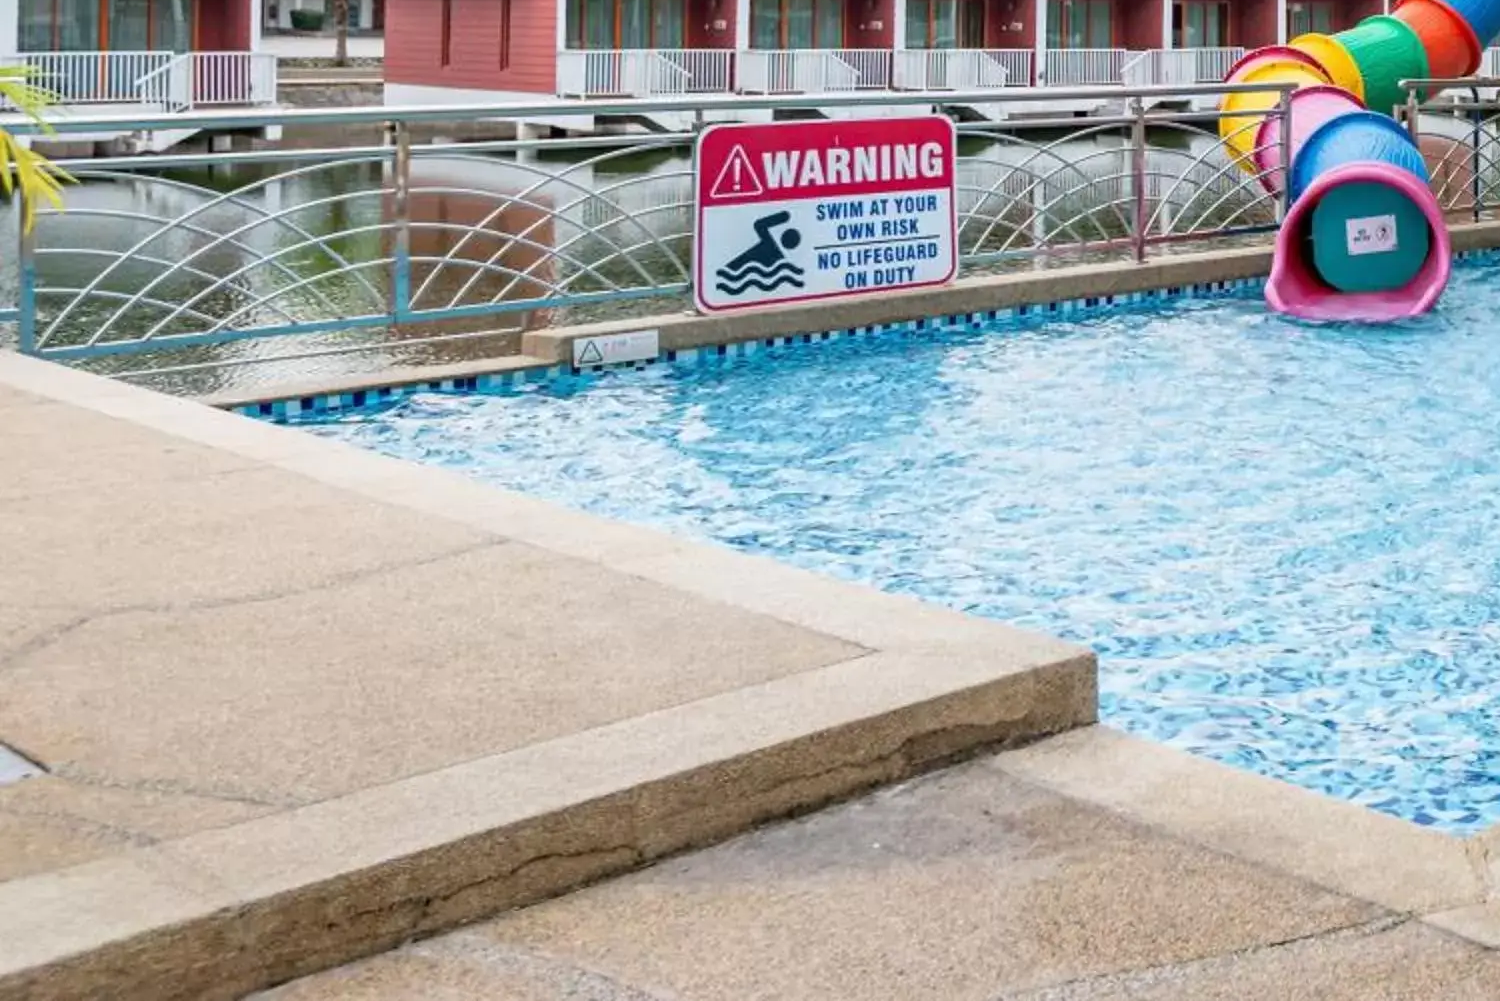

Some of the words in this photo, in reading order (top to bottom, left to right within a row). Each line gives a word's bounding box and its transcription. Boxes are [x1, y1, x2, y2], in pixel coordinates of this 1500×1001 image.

[761, 141, 944, 190] WARNING
[816, 201, 863, 221] SWIM
[870, 199, 889, 215] AT
[894, 195, 937, 214] YOUR
[837, 222, 875, 241] OWN
[881, 219, 919, 236] RISK
[818, 252, 841, 270] NO
[847, 242, 937, 267] LIFEGUARD
[845, 271, 867, 289] ON
[873, 266, 915, 286] DUTY
